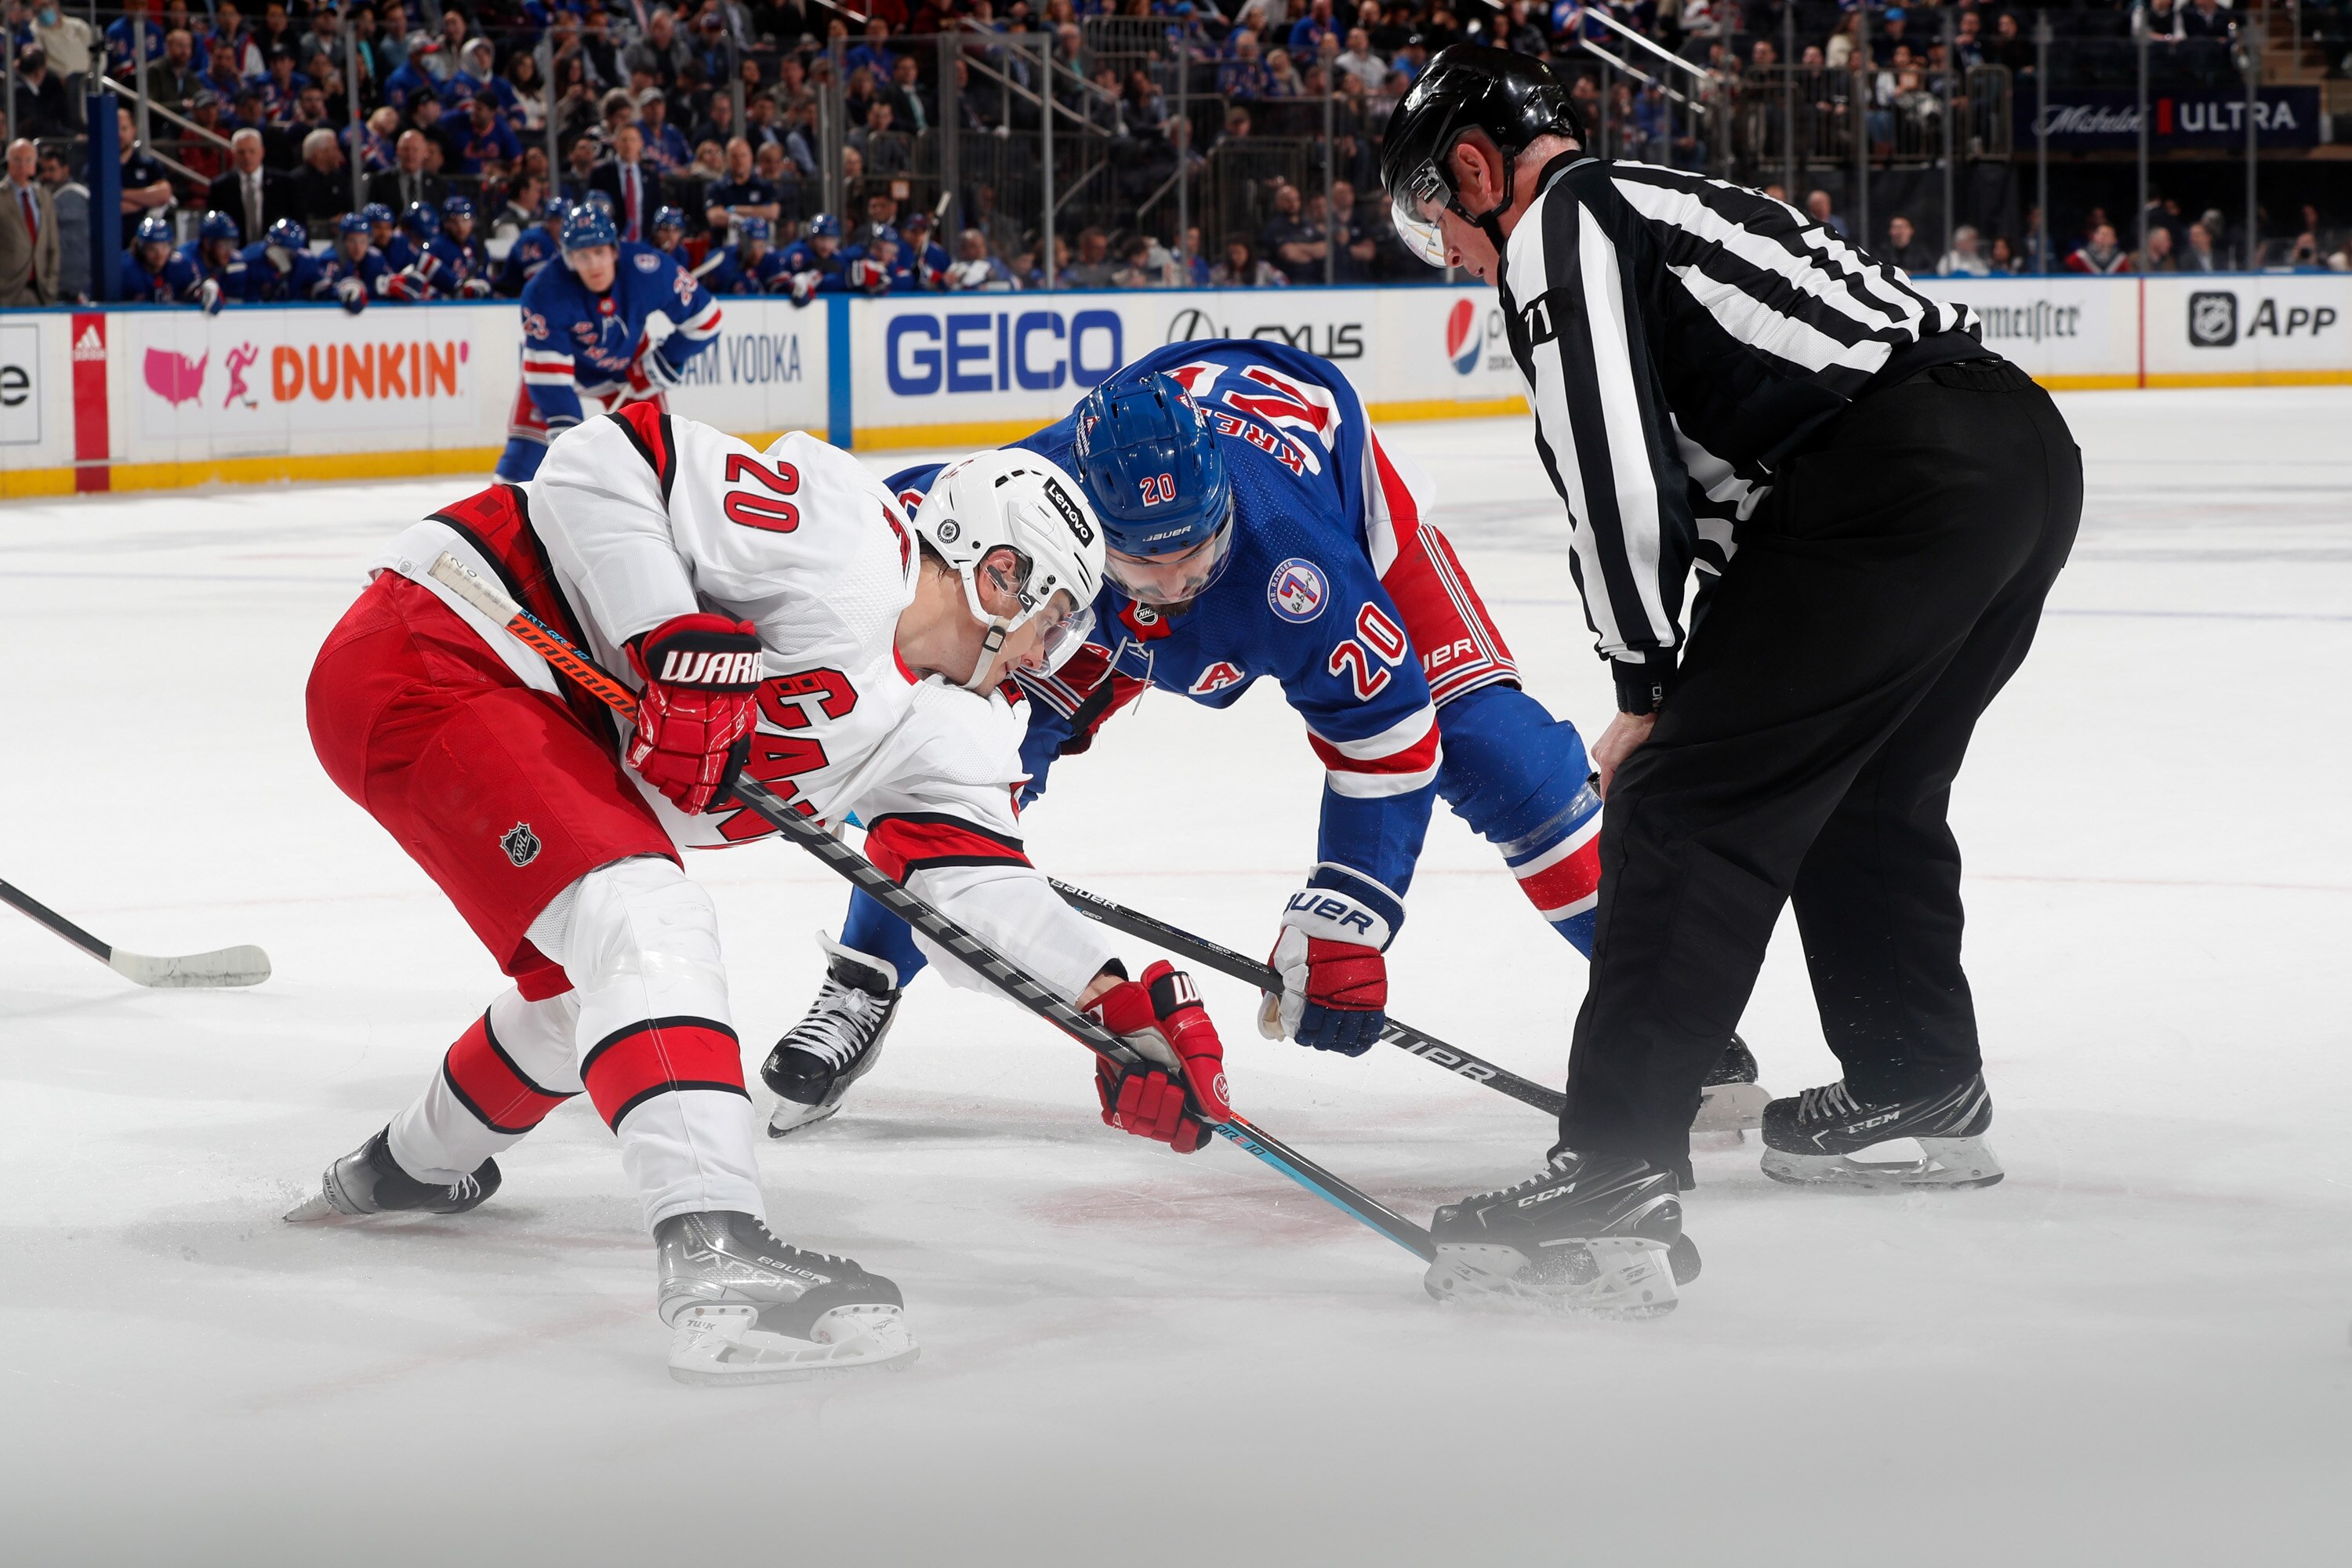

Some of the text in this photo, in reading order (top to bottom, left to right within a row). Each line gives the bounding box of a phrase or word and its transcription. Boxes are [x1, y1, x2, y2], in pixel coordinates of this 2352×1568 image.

[2180, 100, 2298, 132] ULTRA
[727, 333, 801, 385] VODKA
[886, 310, 1123, 397] GEICO
[271, 340, 469, 402] DUNKIN'
[724, 453, 800, 534] 20
[1139, 473, 1176, 507] 20
[1047, 484, 1089, 539] Lenovo
[451, 557, 477, 579] 20
[1271, 561, 1294, 587] RANGER
[1280, 572, 1318, 604] 7
[1329, 601, 1408, 702] 20
[1189, 661, 1246, 695] A
[514, 833, 528, 862] NHL
[1051, 878, 1118, 911] BAUER
[1284, 892, 1374, 935] UER
[1246, 1143, 1267, 1156] 10
[1518, 1182, 1577, 1208] CCM
[757, 1255, 832, 1285] BAUER
